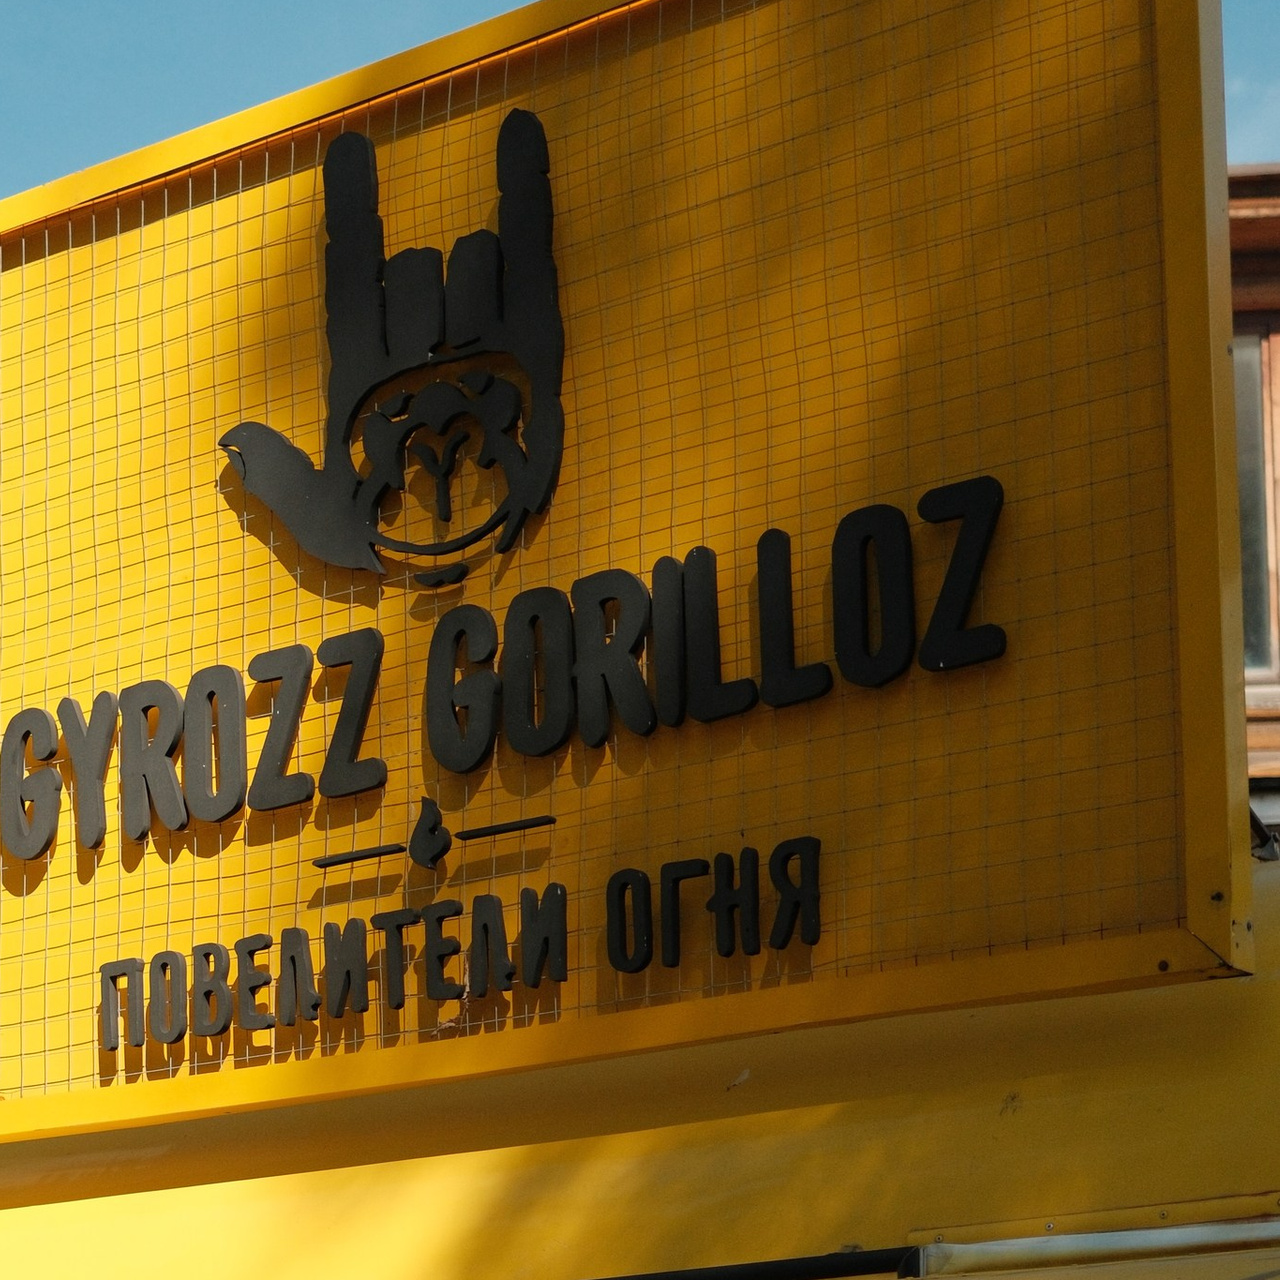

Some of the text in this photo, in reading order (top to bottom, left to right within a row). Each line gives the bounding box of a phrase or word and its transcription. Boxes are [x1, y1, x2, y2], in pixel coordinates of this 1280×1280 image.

[427, 475, 1006, 773] GORILLOZ
[99, 835, 821, 1050] ПОВЕЛИТЕЛИ ОГНЯ
